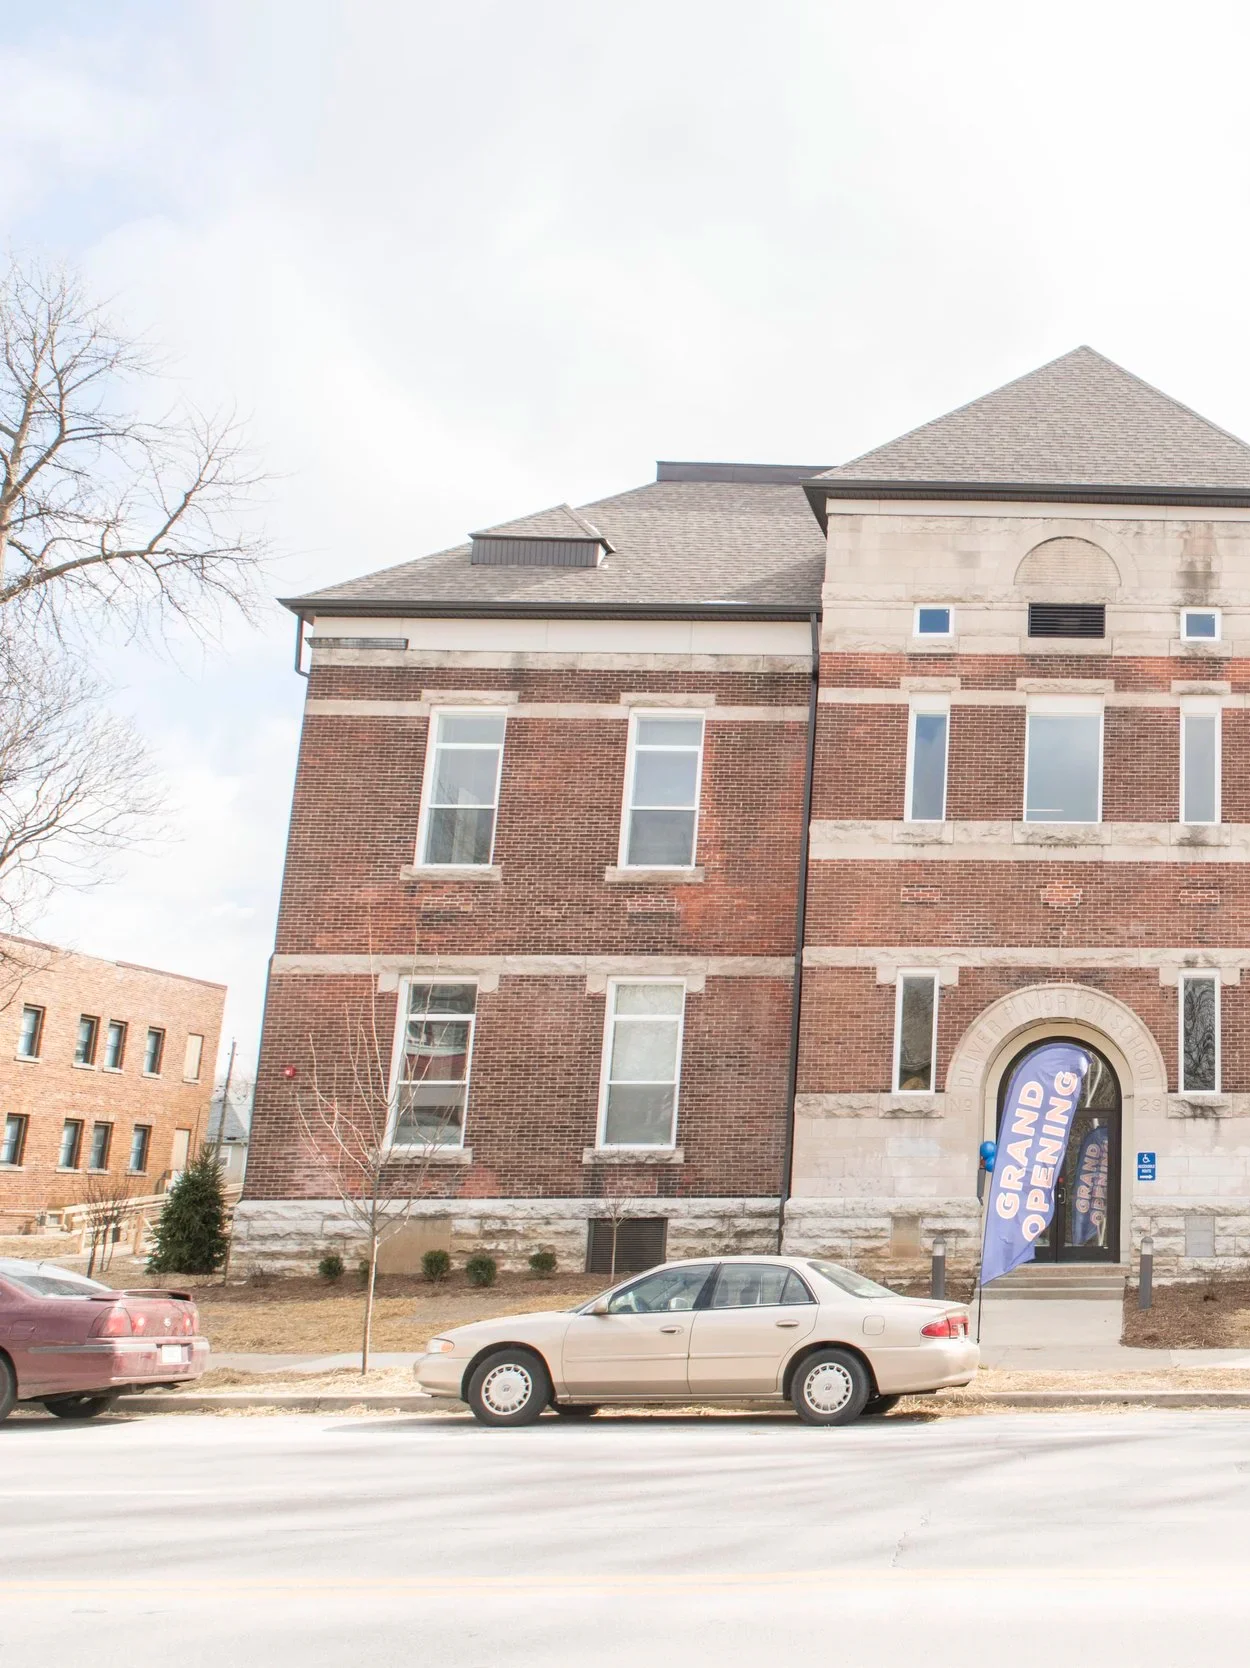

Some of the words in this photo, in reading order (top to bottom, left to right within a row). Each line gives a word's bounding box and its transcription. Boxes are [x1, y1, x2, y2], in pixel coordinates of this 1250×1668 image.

[957, 1019, 1002, 1088] OLIVER
[1109, 1014, 1157, 1088] SCHOOL
[1139, 1098, 1161, 1112] 29
[996, 1081, 1044, 1219] GRAND
[1022, 1071, 1078, 1242] OPENING
[1075, 1143, 1101, 1213] GRAND
